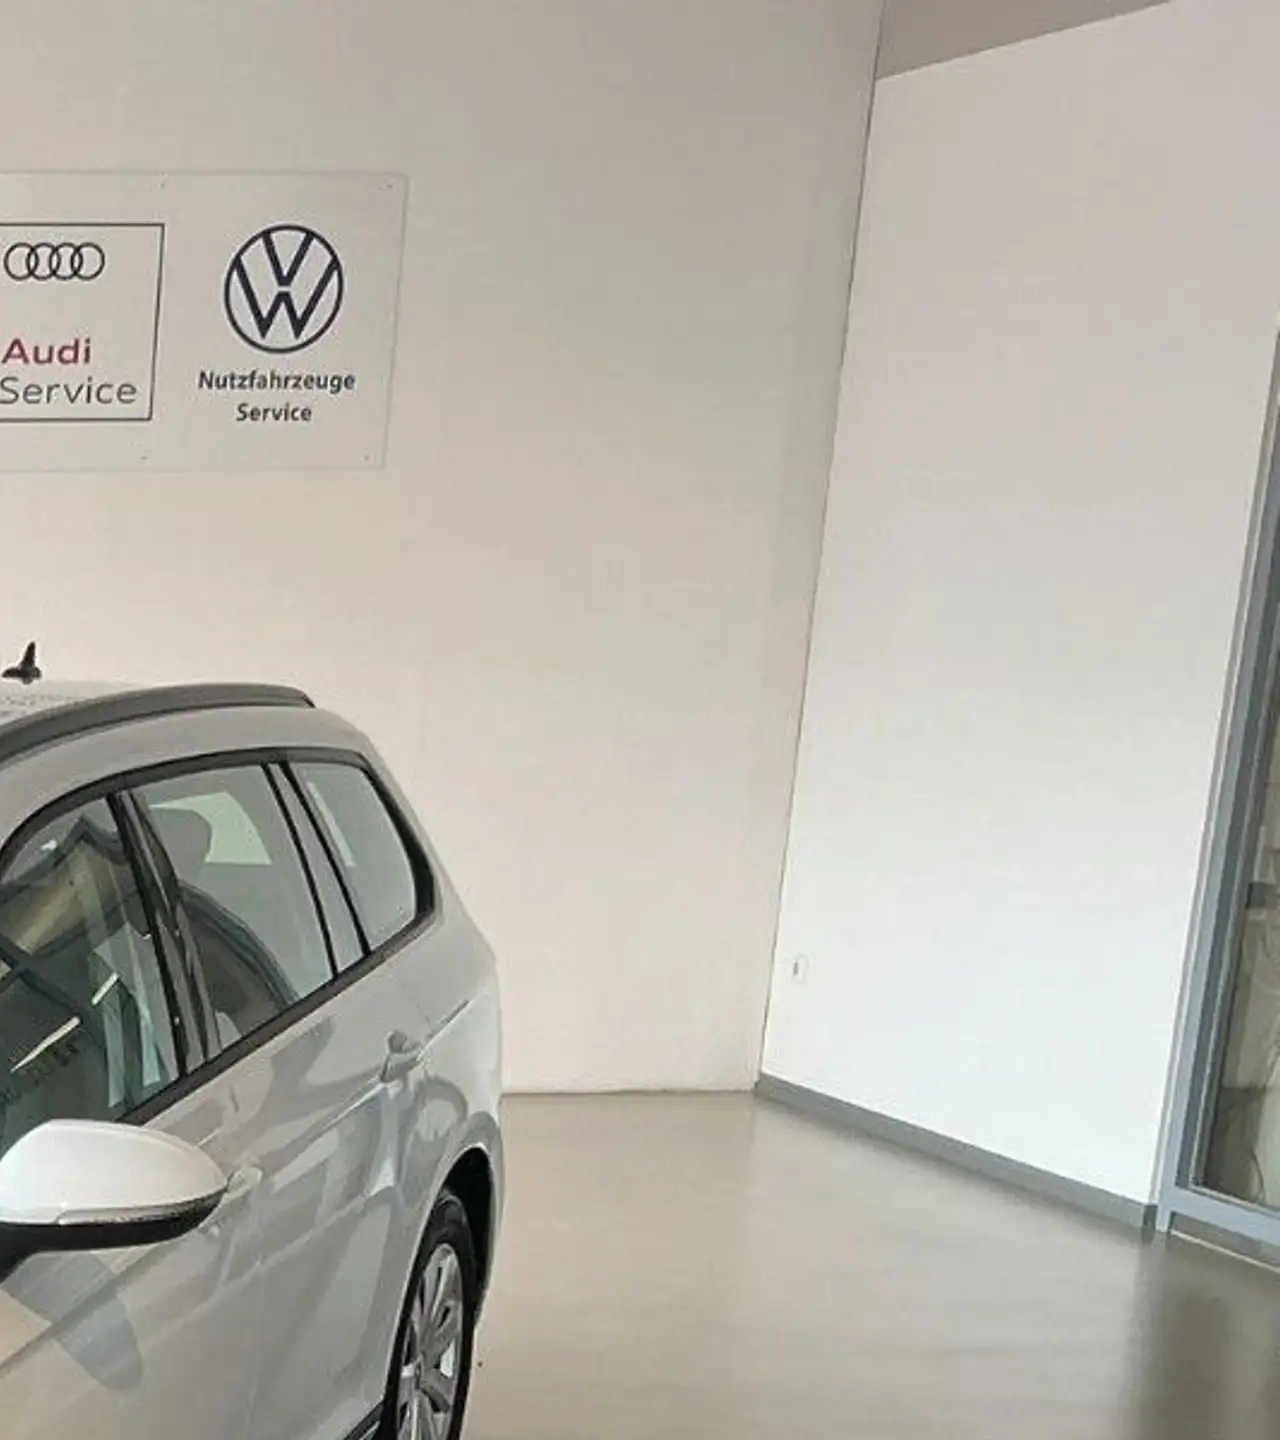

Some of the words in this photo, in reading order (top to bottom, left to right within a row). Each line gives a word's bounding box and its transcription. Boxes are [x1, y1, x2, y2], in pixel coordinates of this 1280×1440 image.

[0, 336, 92, 366] Audi
[197, 367, 357, 395] Nutzfahrzeuge
[235, 401, 313, 423] Service
